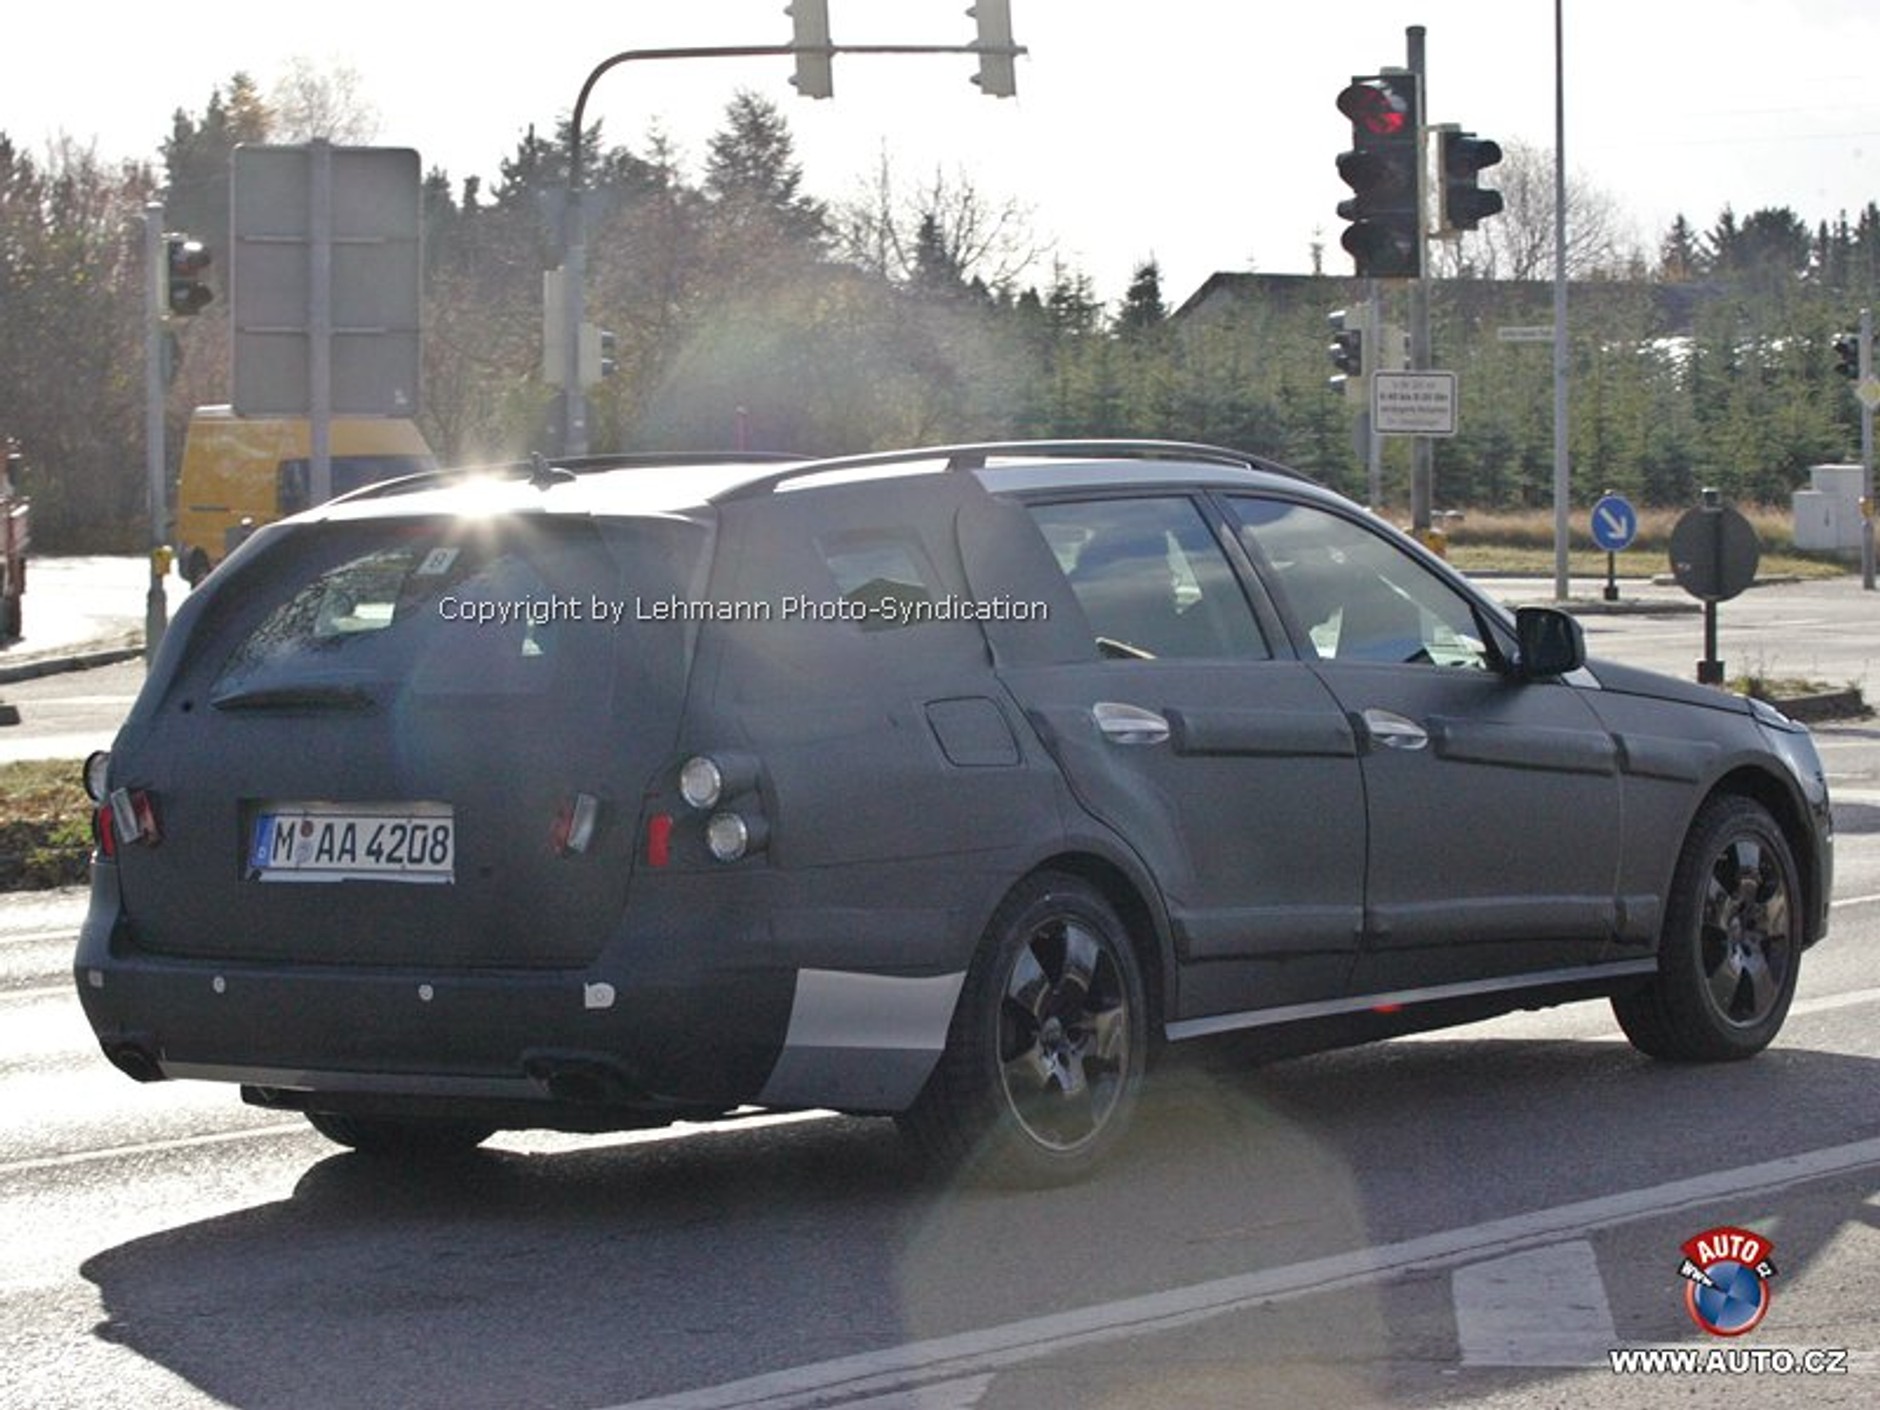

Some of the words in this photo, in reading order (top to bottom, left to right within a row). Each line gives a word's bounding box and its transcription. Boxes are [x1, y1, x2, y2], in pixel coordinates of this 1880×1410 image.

[272, 821, 296, 862] M
[315, 822, 356, 863] AA
[365, 823, 449, 865] 4208
